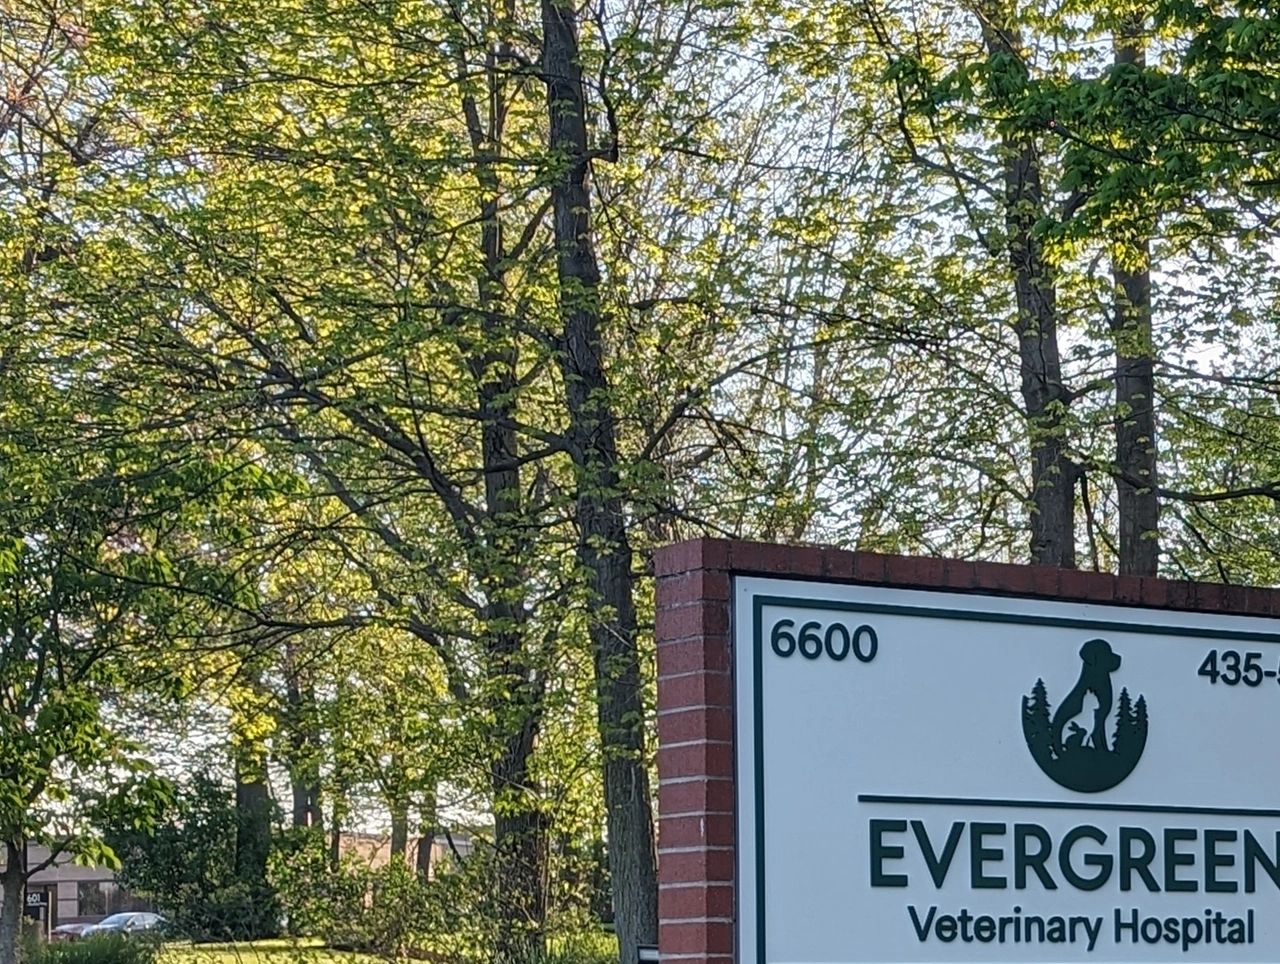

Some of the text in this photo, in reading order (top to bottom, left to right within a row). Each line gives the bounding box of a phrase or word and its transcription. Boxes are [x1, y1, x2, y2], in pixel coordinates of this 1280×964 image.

[771, 619, 879, 662] 6600
[907, 906, 1255, 952] Veterinary Hospital
